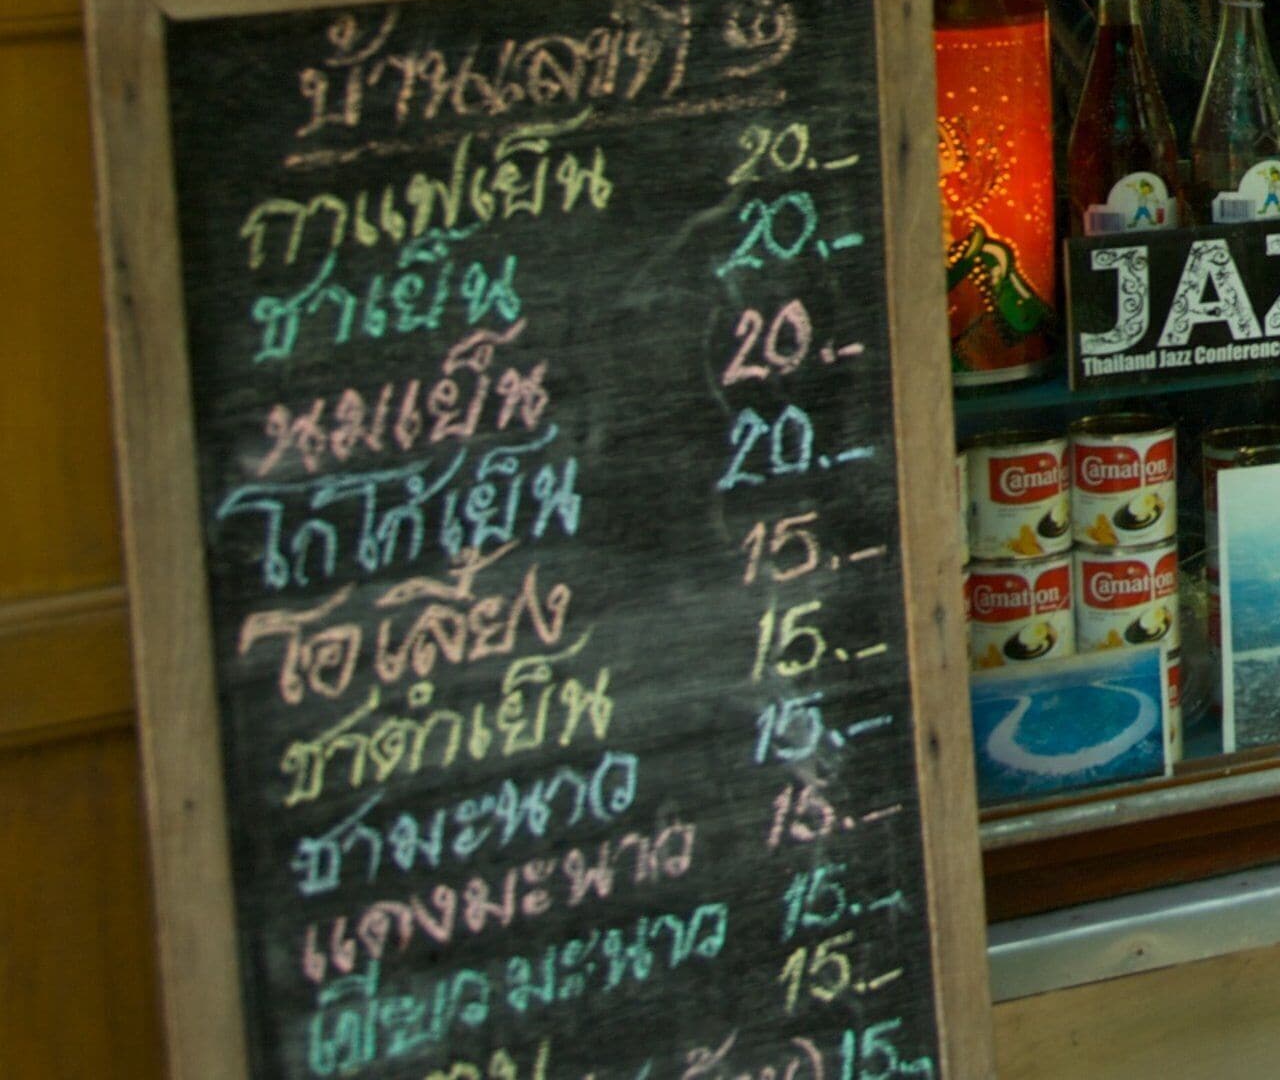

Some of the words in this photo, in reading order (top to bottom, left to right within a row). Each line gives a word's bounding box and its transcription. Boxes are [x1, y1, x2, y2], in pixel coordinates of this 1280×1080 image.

[239, 108, 613, 271] กาแฟเย็น
[253, 221, 522, 362] ชาเย็น
[1081, 347, 1157, 377] Thailand
[1158, 344, 1192, 369] Jazz
[1081, 455, 1168, 486] Carnation
[240, 541, 572, 704] โอเลี้ยง
[973, 585, 1061, 614] Carnation
[1090, 571, 1175, 602] Carnation
[291, 751, 639, 895] ชามะนาว
